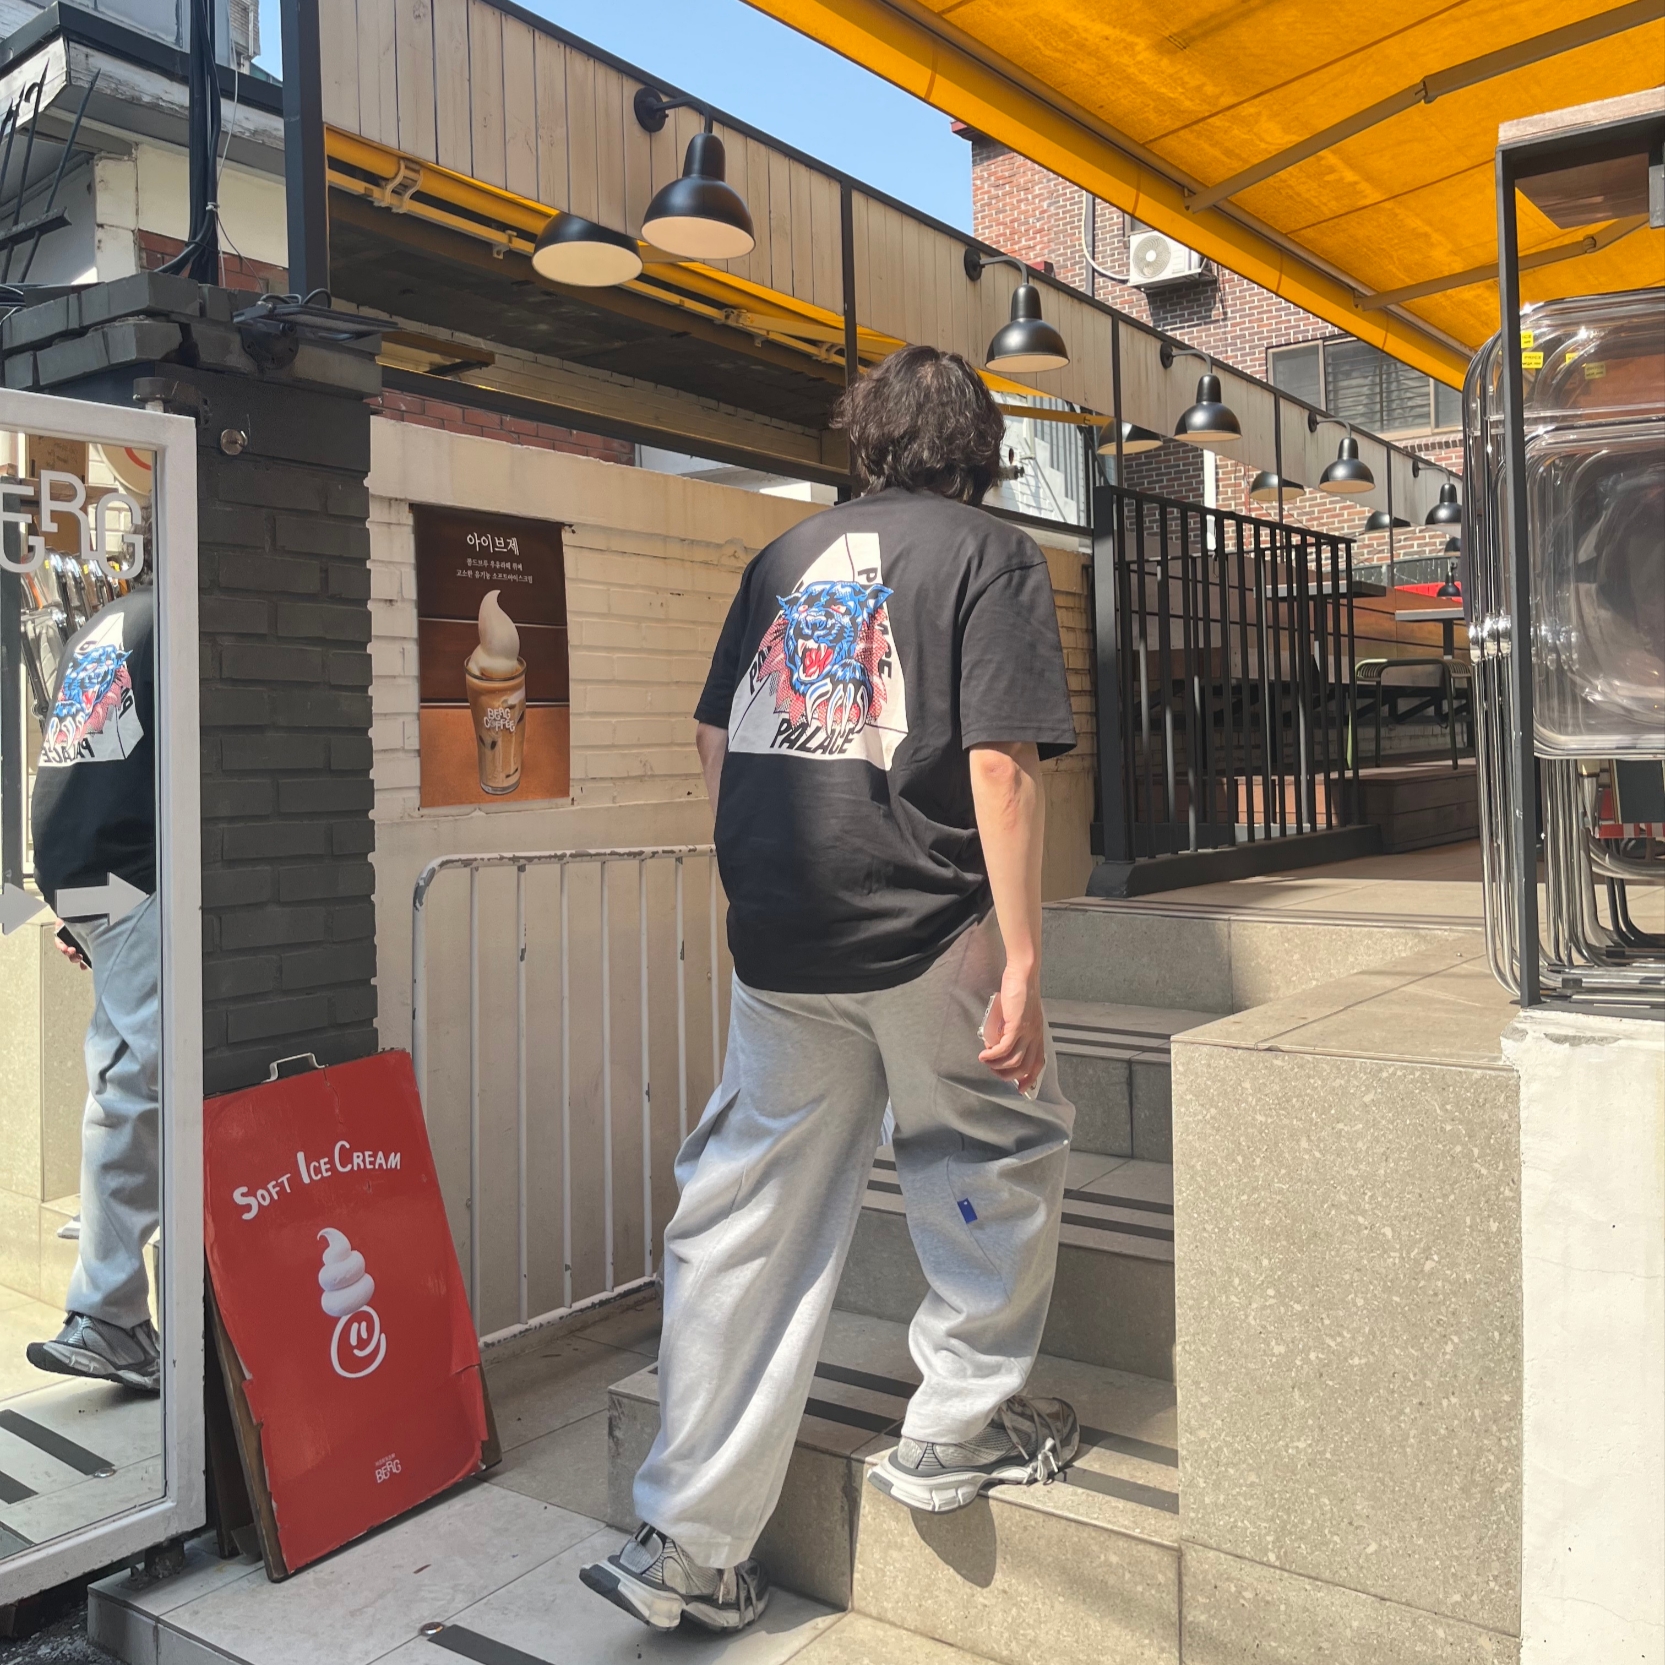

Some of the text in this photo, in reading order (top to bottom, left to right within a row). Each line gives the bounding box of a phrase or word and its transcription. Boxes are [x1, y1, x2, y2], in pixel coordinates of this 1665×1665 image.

[467, 532, 520, 556] 아이브제
[456, 569, 473, 578] 고소한
[487, 707, 511, 720] BERG
[232, 1140, 401, 1220] SOFT ICE CREAM
[375, 1459, 402, 1483] BERG
